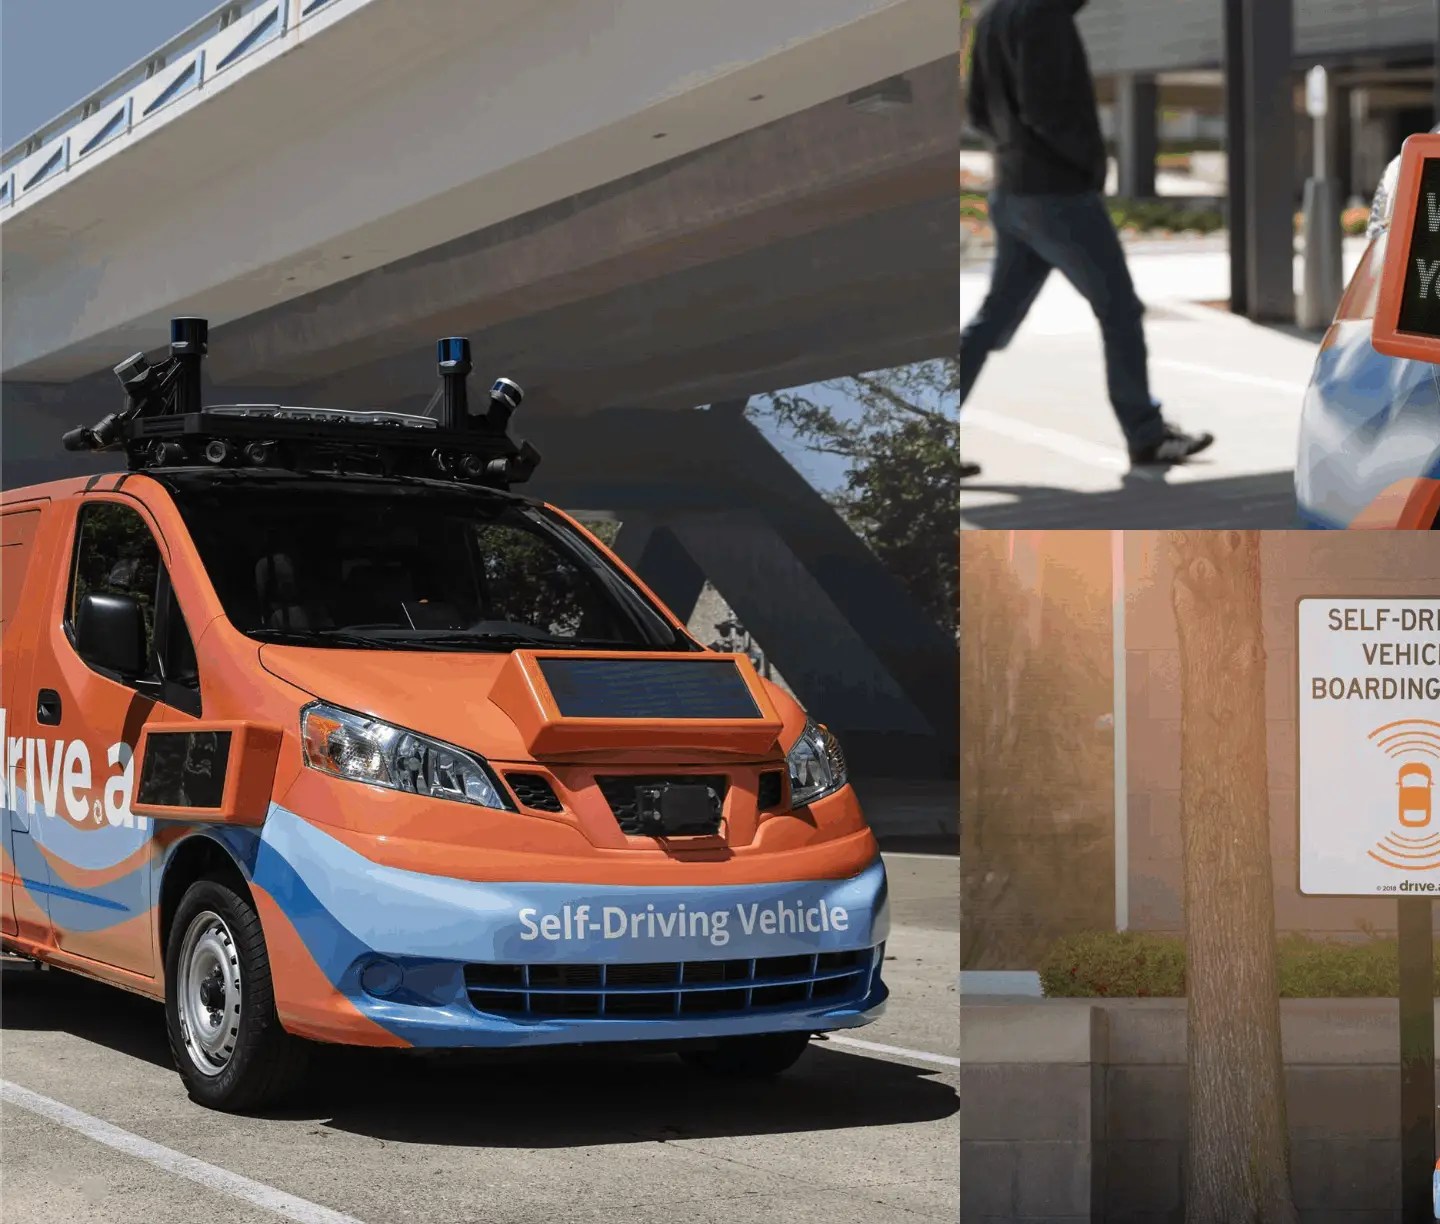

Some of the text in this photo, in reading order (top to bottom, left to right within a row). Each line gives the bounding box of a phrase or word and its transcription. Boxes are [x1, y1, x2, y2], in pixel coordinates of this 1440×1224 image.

[0, 708, 148, 830] rive.a
[518, 899, 849, 946] Self-Driving Vehicle
